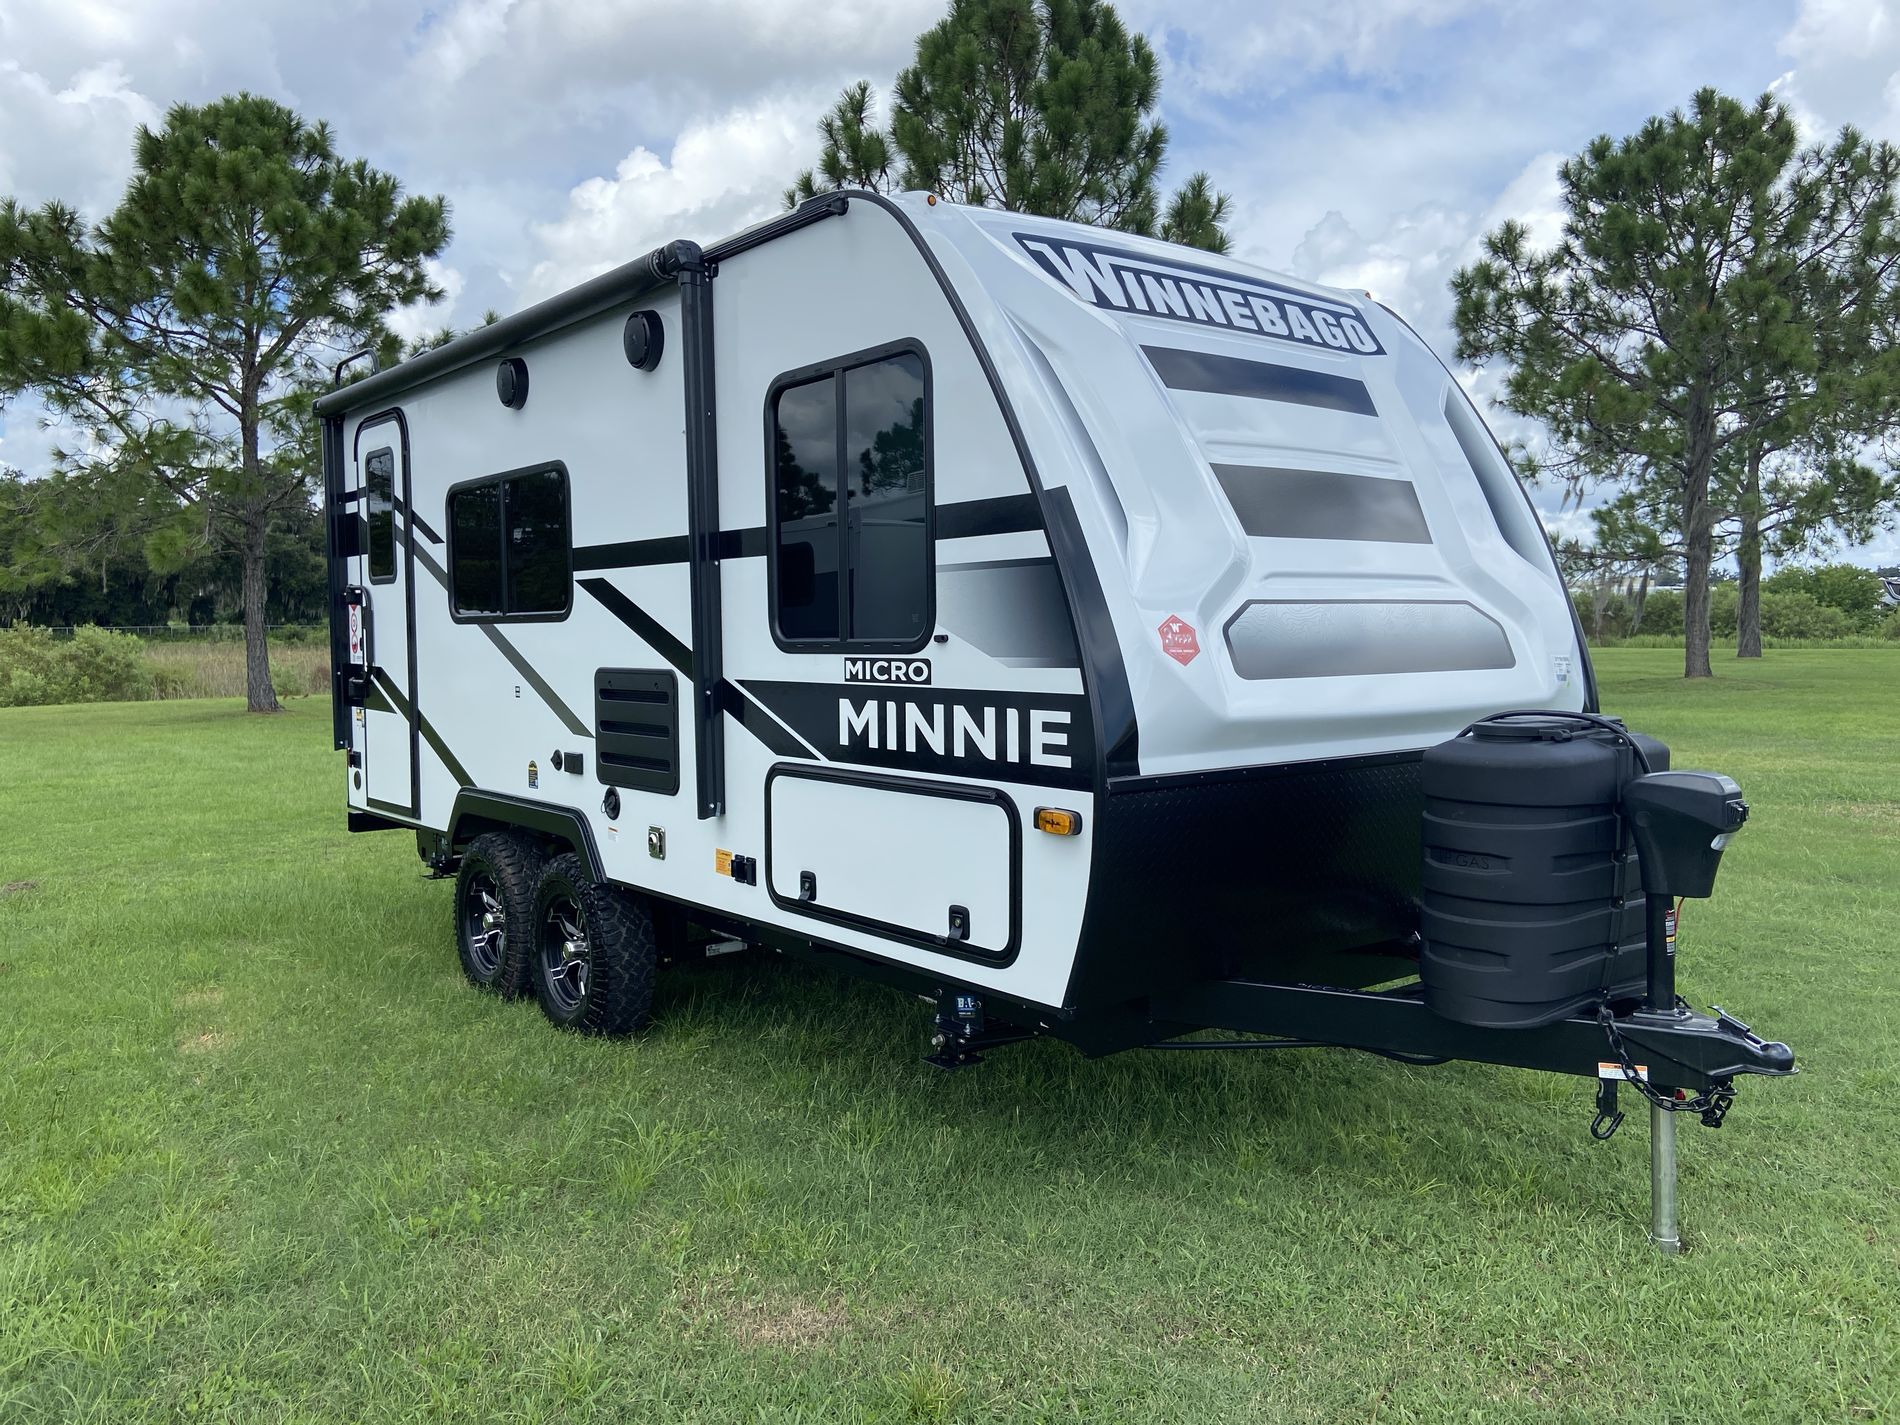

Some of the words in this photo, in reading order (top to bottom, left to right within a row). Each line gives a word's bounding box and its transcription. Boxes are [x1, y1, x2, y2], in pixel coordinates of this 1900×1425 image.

[1022, 239, 1379, 354] WINNEBAGO
[845, 660, 929, 682] MICRO
[838, 698, 1072, 769] MINNIE
